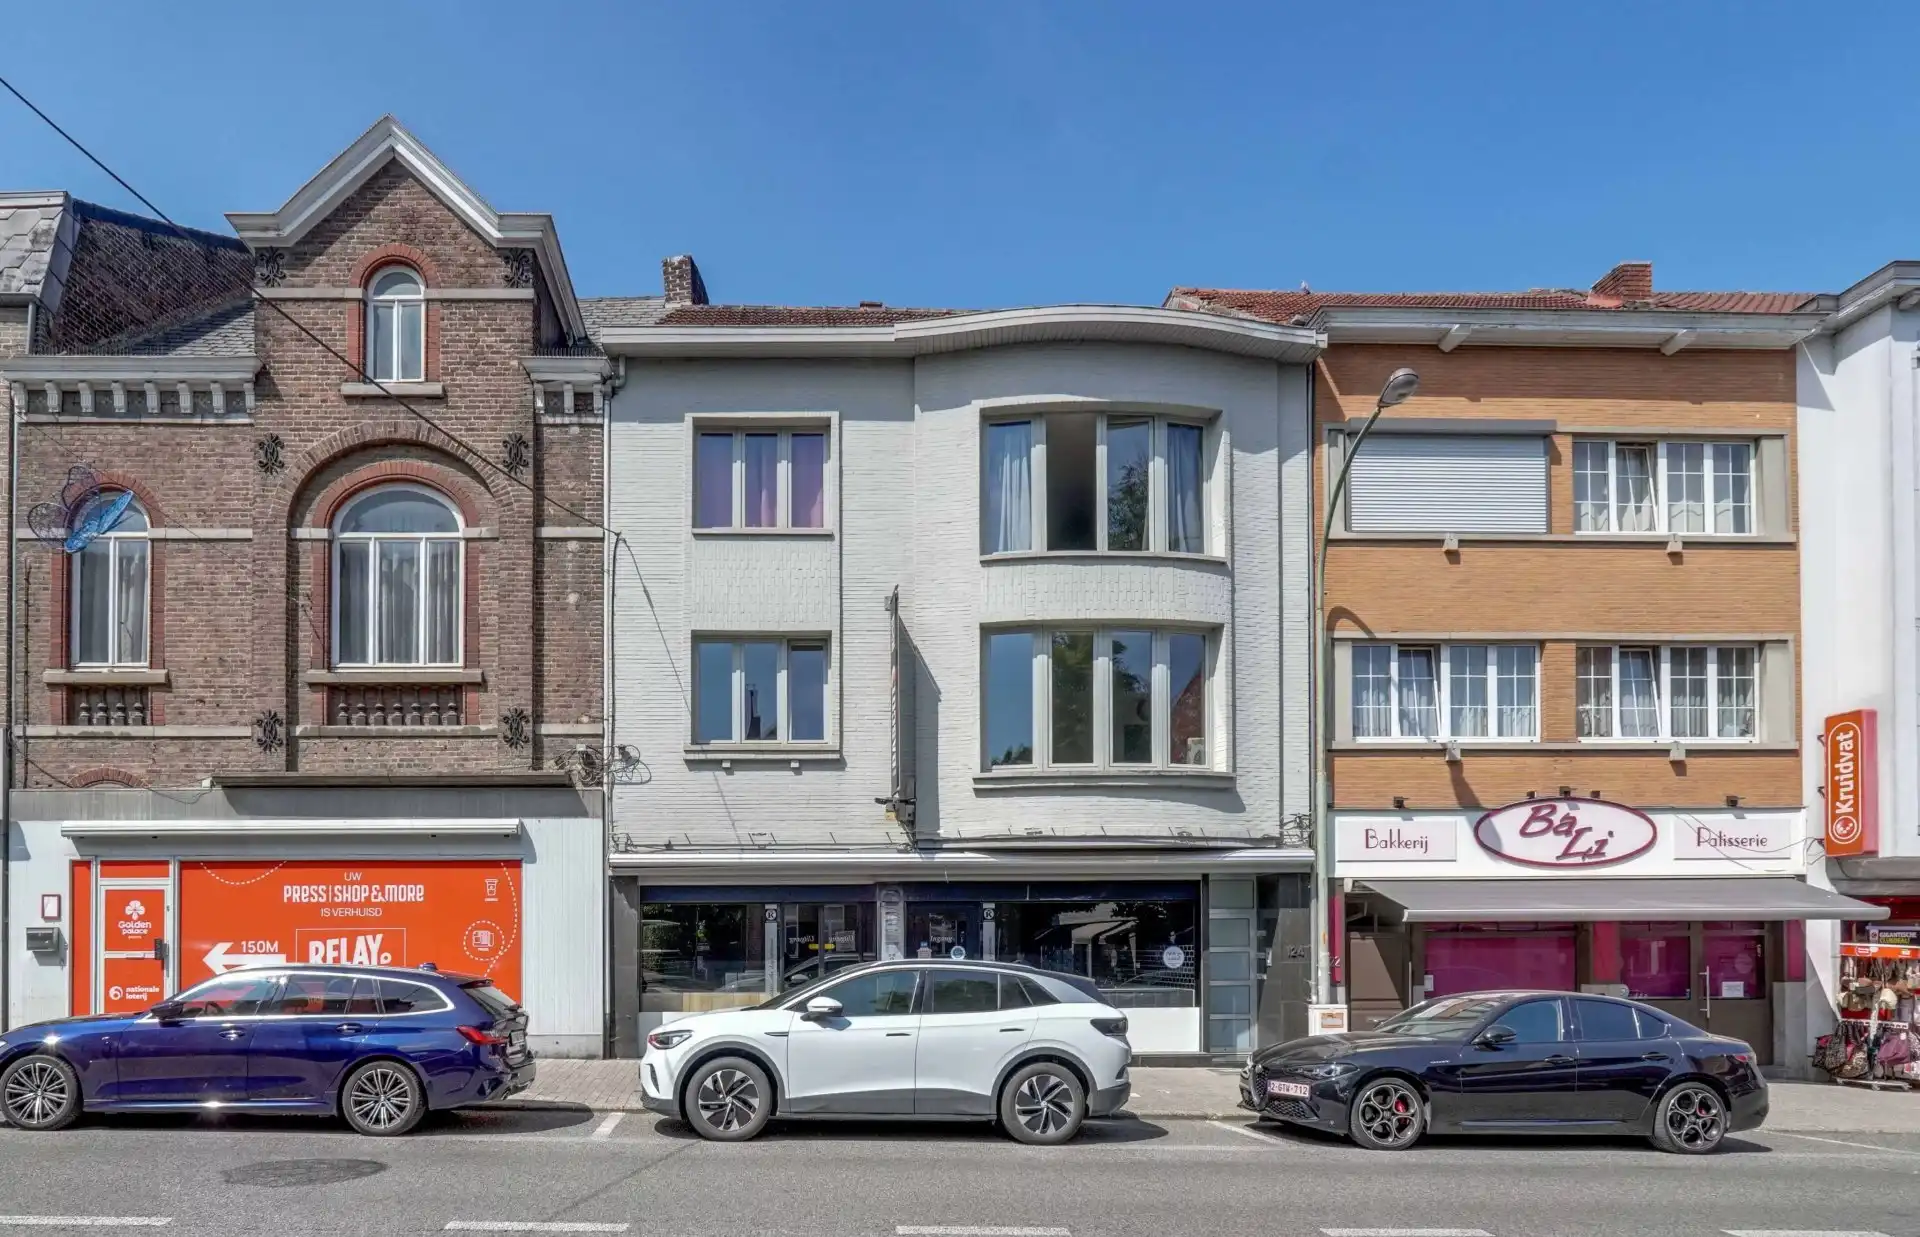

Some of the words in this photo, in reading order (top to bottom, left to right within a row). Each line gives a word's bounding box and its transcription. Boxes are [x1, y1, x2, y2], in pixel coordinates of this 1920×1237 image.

[1835, 730, 1854, 815] Kruidvat
[1519, 803, 1578, 838] Ba
[1364, 828, 1429, 854] Bakkerij
[1696, 827, 1768, 847] Patisserie
[344, 872, 363, 882] UW
[320, 907, 331, 917] IS
[331, 907, 383, 917] VERHUISD
[118, 920, 152, 929] Golden
[240, 940, 279, 953] 150M
[125, 993, 148, 1001] loterij
